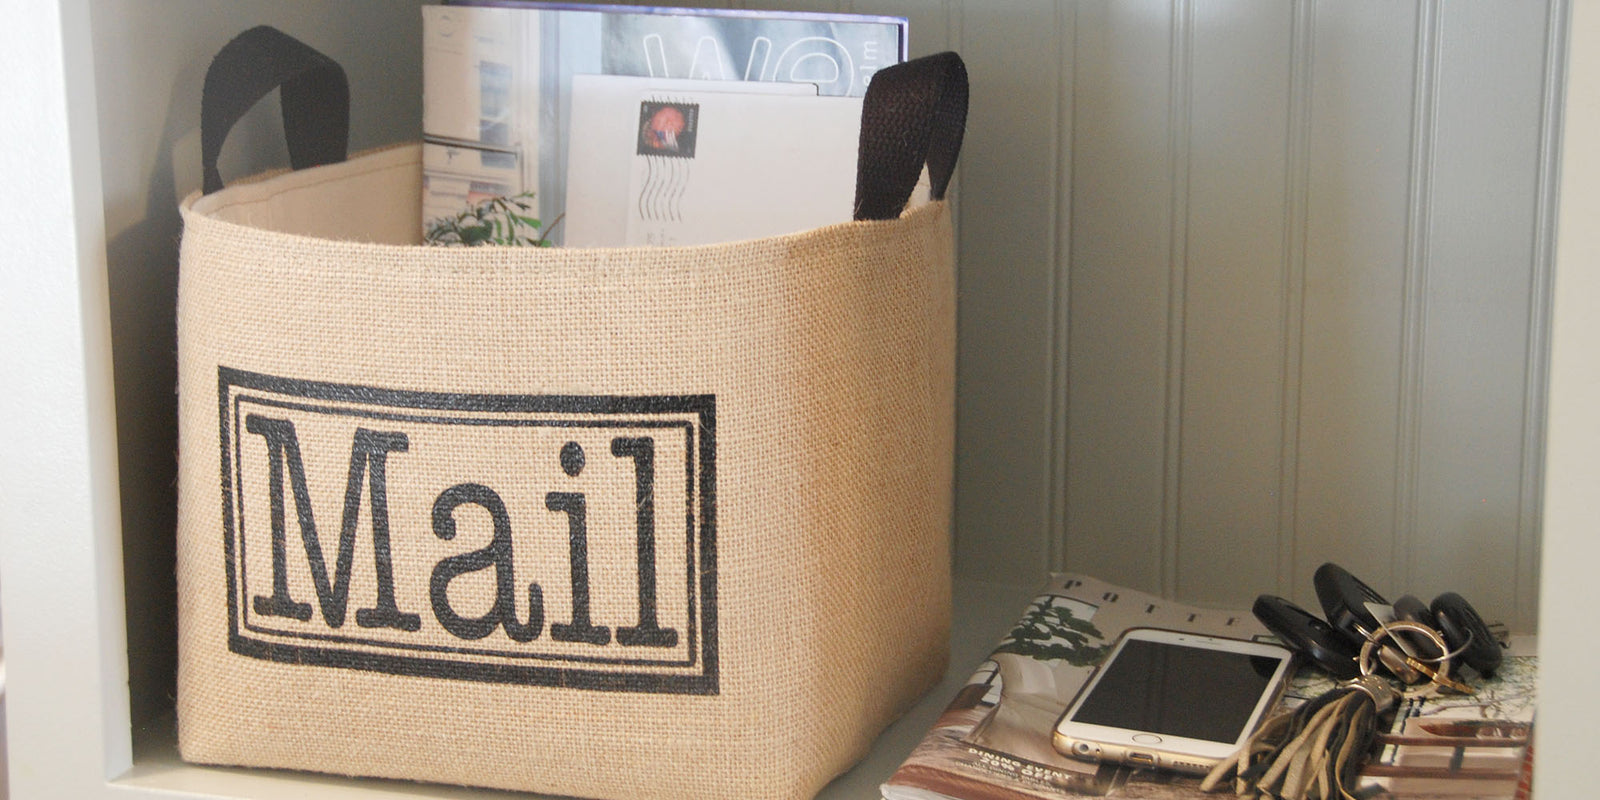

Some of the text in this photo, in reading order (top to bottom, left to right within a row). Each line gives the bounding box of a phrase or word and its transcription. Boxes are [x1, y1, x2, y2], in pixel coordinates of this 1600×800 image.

[245, 413, 679, 648] Mail
[1063, 579, 1242, 626] POTTE
[968, 748, 1021, 767] DINING
[1026, 764, 1072, 780] EVENT
[1021, 768, 1053, 781] OFF
